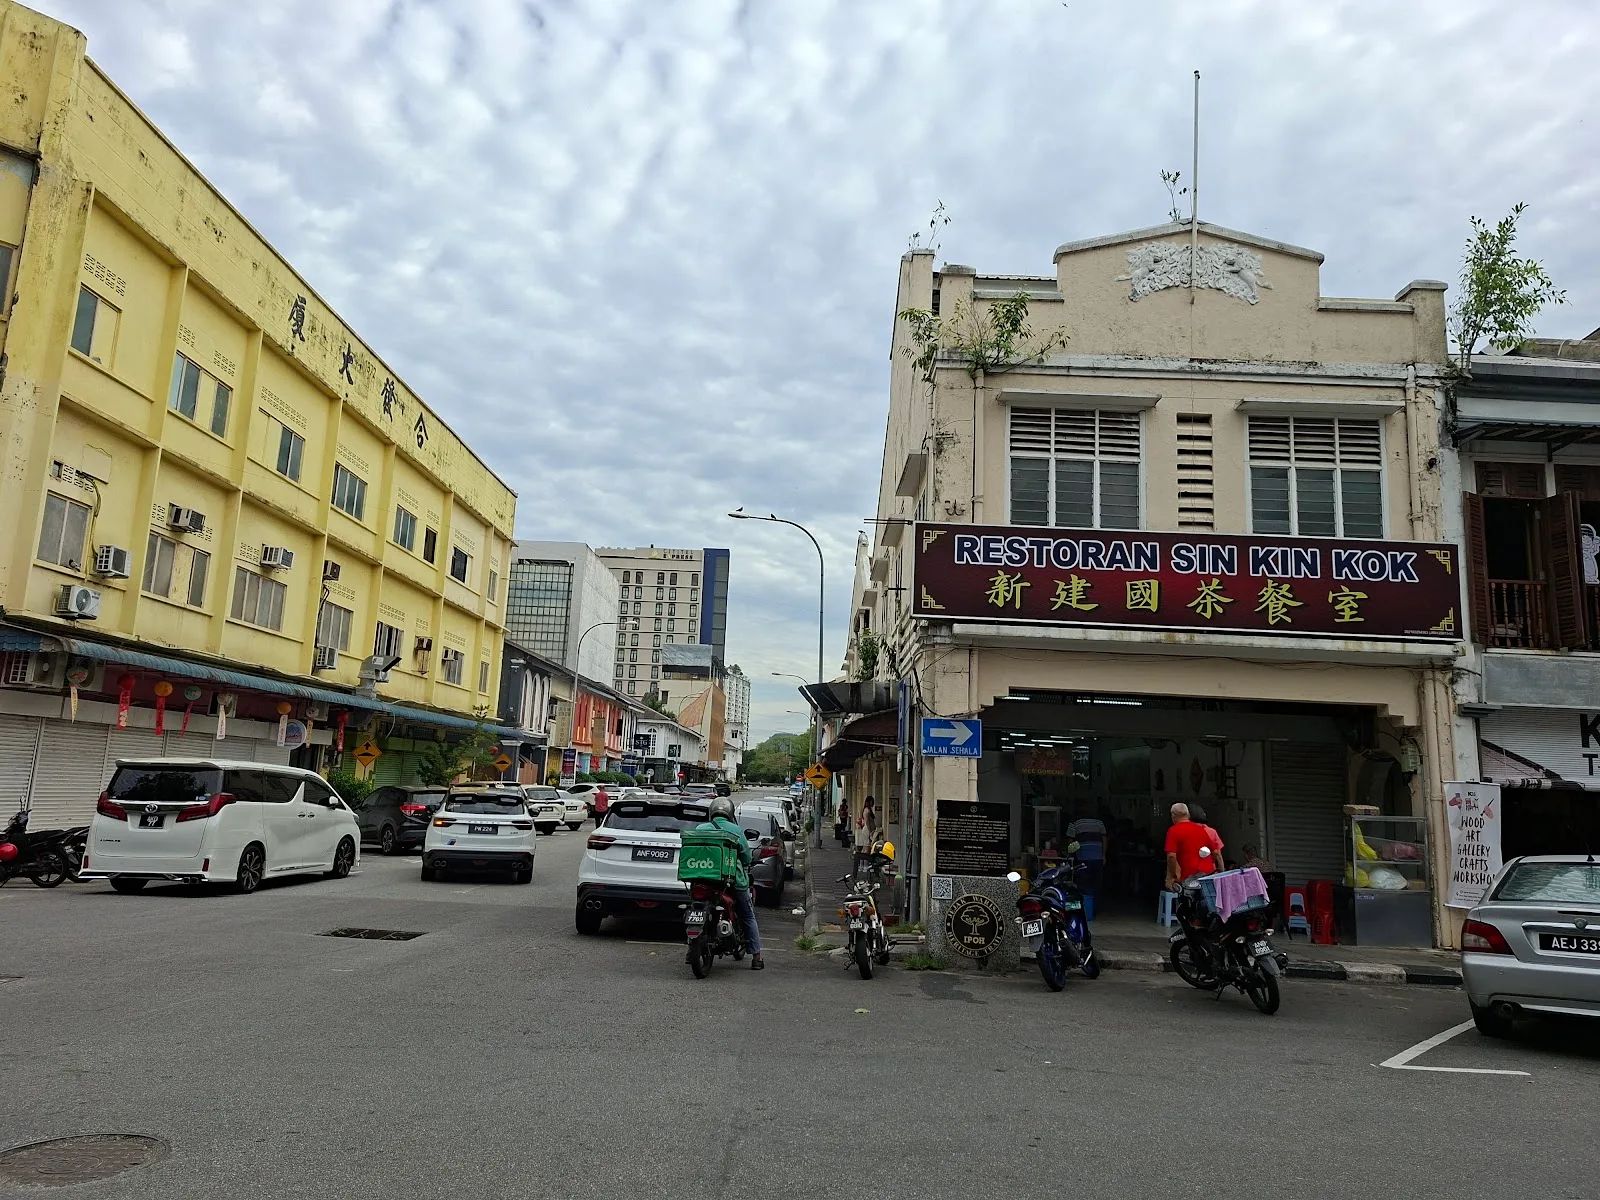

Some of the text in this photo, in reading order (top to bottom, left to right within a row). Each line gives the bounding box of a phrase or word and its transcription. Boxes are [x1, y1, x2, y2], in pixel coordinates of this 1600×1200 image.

[954, 533, 1420, 584] RESTORAN SIN KIN KOK
[985, 570, 1369, 625] 新建國茶餐室
[926, 745, 978, 756] JALAN SEHALA
[1461, 815, 1485, 829] WOOD
[1465, 830, 1481, 842] ART
[636, 849, 669, 859] ANF 9082
[1457, 843, 1491, 858] GALLERY
[686, 857, 715, 869] Grab
[1459, 858, 1489, 872] CRAFTS
[947, 895, 1003, 922] JEJAK WARISAN
[947, 931, 1003, 957] HERITAGE TRAIL
[963, 936, 986, 945] IPOH
[1551, 936, 1577, 950] AEJ
